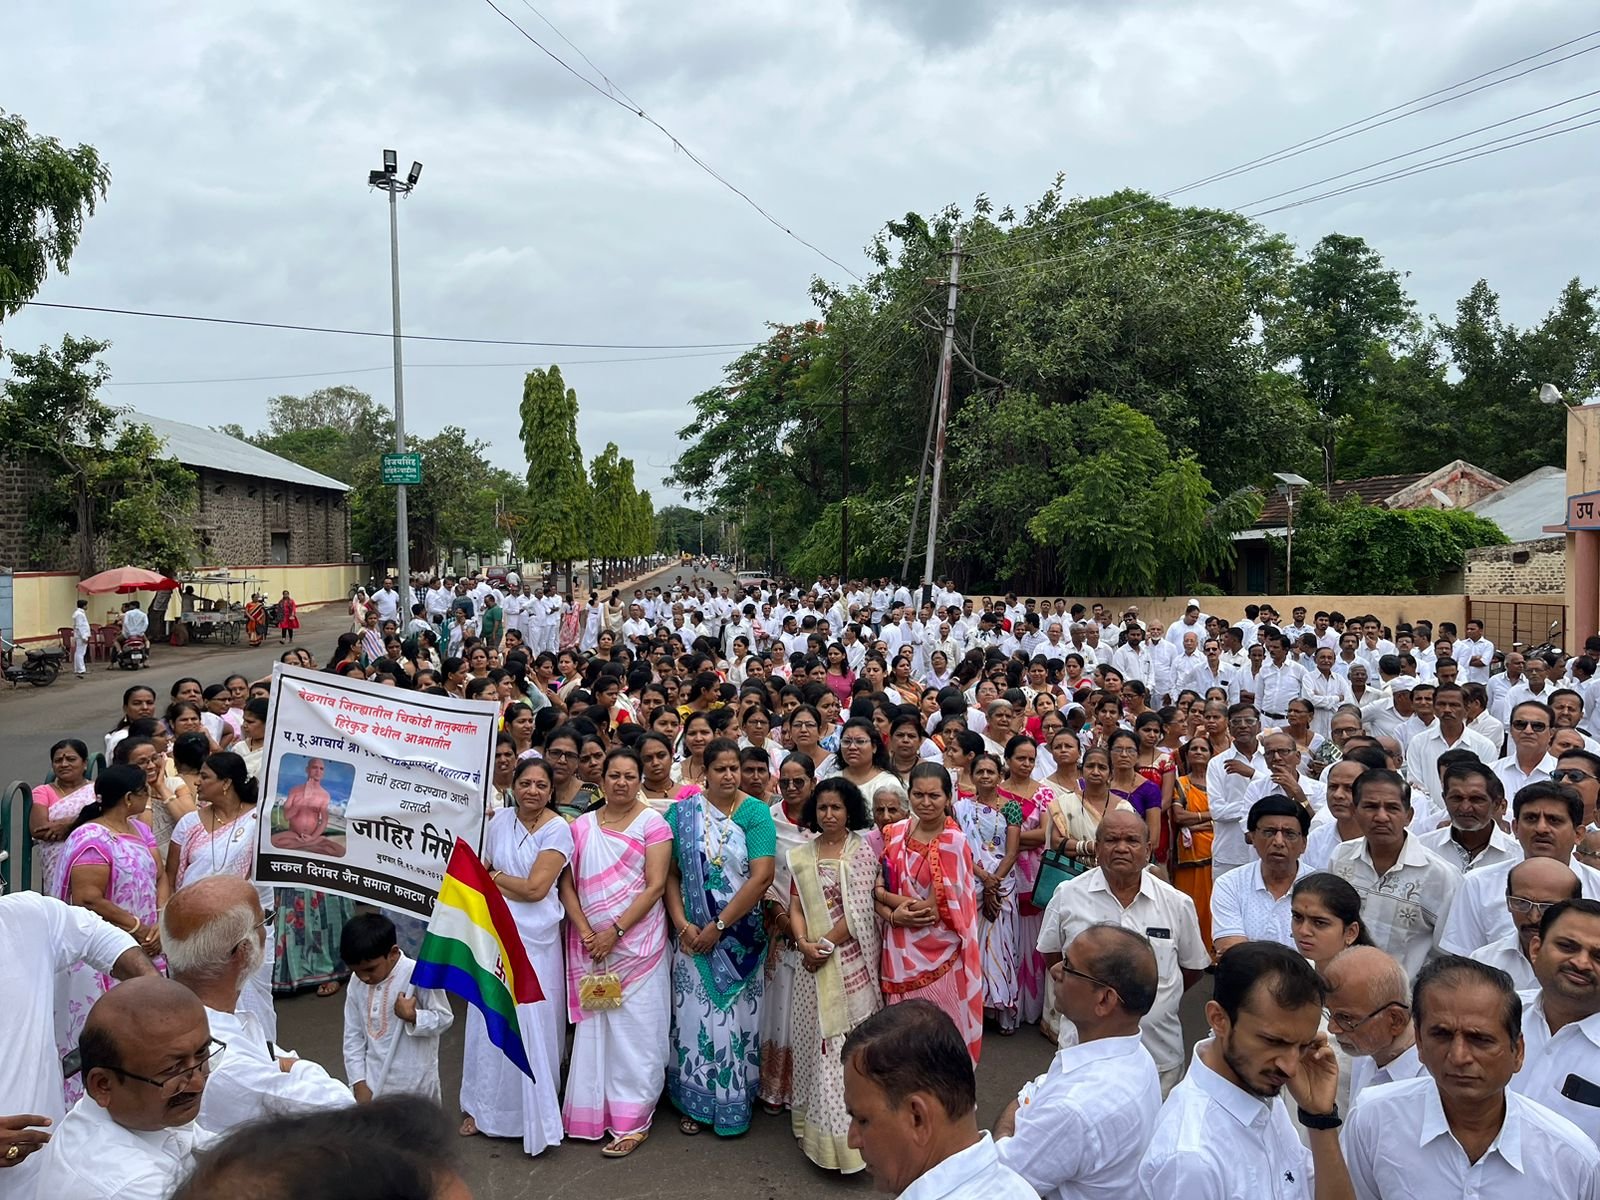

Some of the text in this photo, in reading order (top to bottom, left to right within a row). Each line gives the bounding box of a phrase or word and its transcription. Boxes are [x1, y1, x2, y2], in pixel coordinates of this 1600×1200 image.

[1576, 502, 1594, 520] उप
[335, 714, 451, 750] हिरेकुड येथील आश्रमातील
[339, 697, 393, 720] जिल्ह्यातील
[396, 709, 432, 728] चिकोडी
[434, 720, 478, 736] तालुक्यातील
[366, 771, 469, 807] यांची हत्या करण्यात आली
[438, 766, 471, 782] महाराज
[399, 800, 431, 814] यासाठी
[351, 816, 455, 864] जाहिर निषे
[270, 861, 303, 874] सकल
[342, 868, 360, 884] जैन
[363, 876, 392, 893] समाज
[394, 884, 425, 904] फलटण
